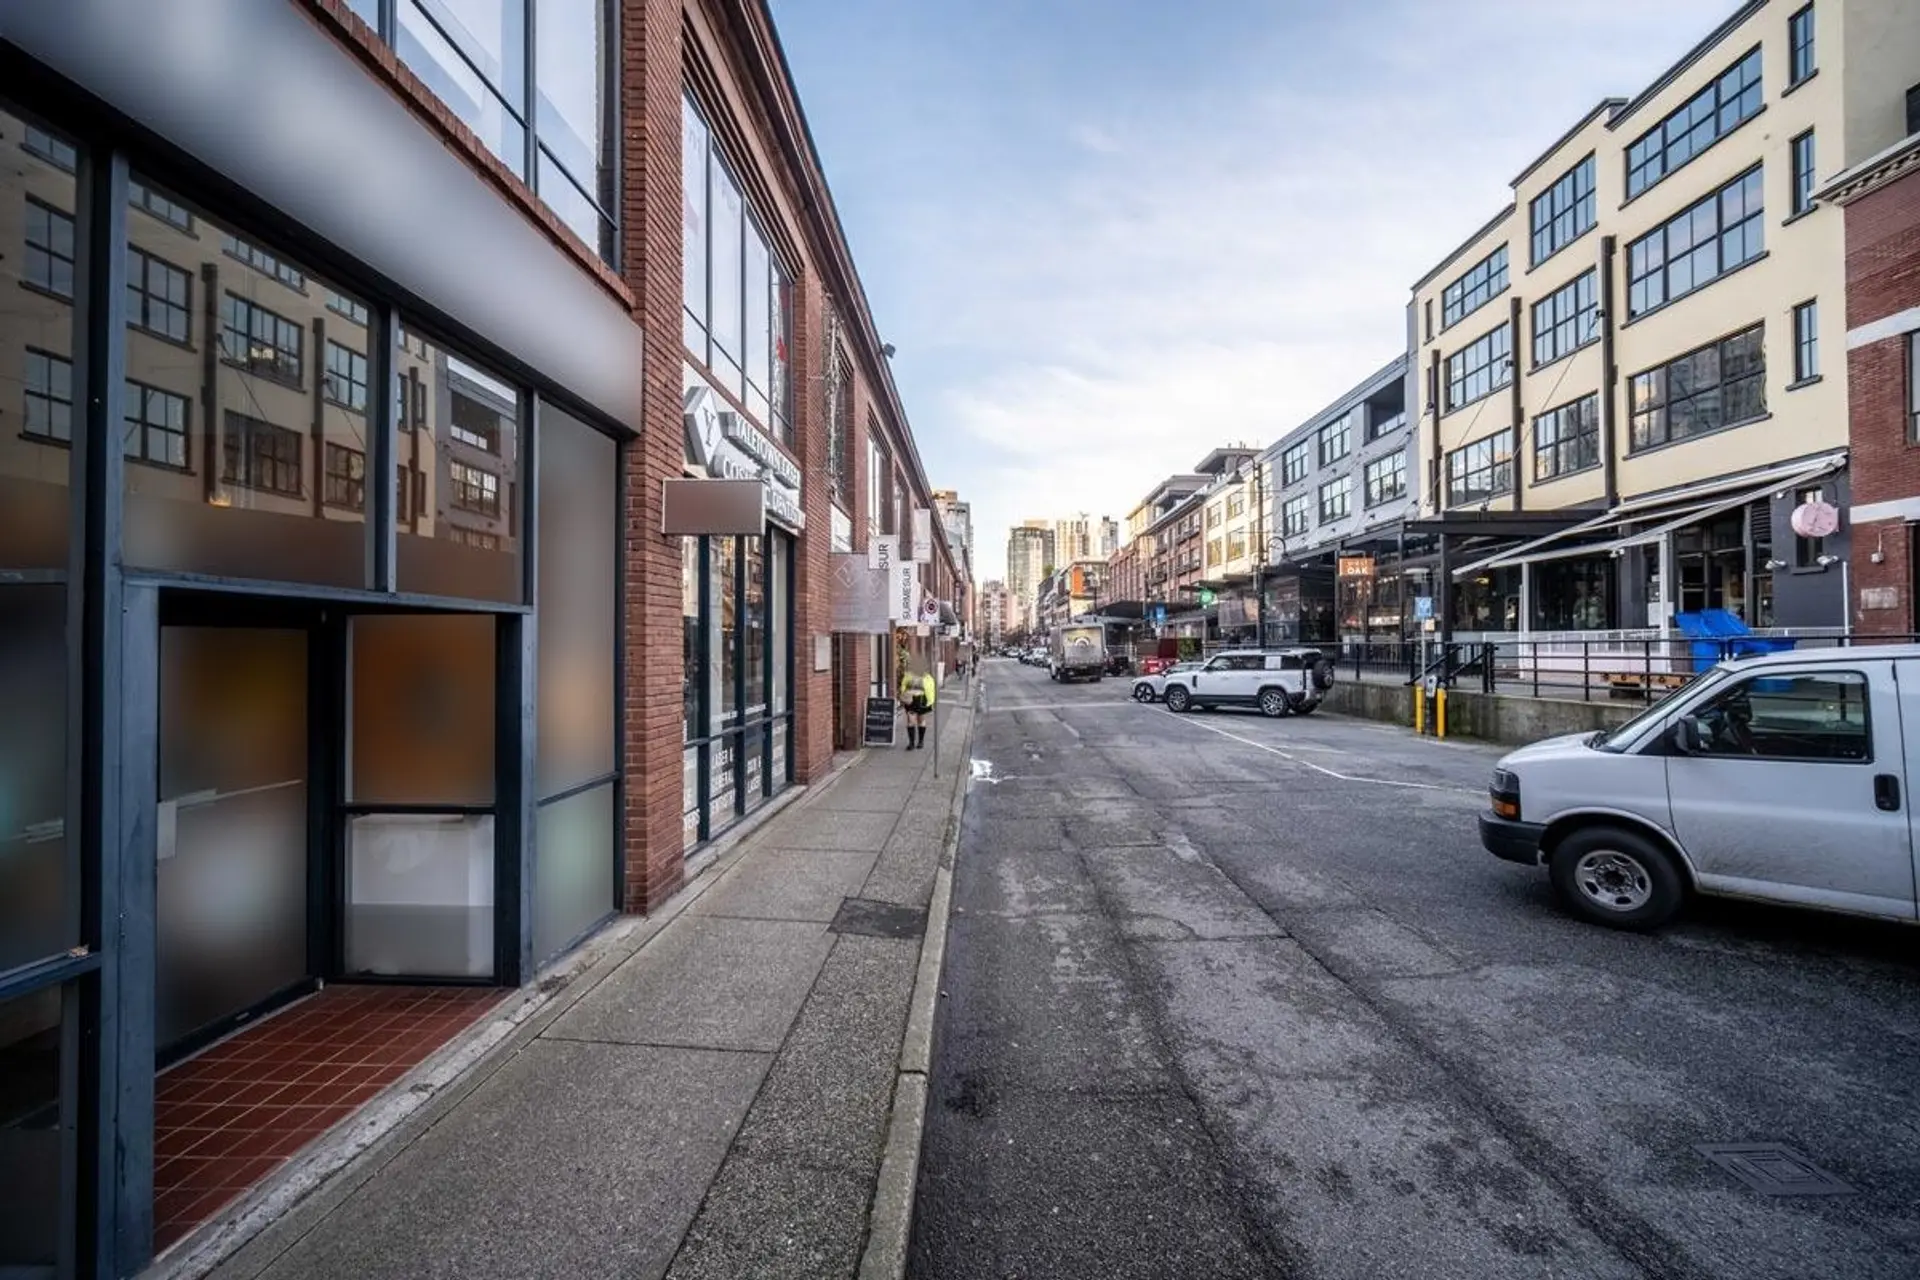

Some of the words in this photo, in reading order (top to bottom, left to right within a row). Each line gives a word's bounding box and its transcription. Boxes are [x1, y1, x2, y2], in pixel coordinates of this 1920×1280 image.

[702, 406, 716, 447] Y
[1347, 567, 1368, 575] OAK
[902, 567, 911, 620] SURMESUR
